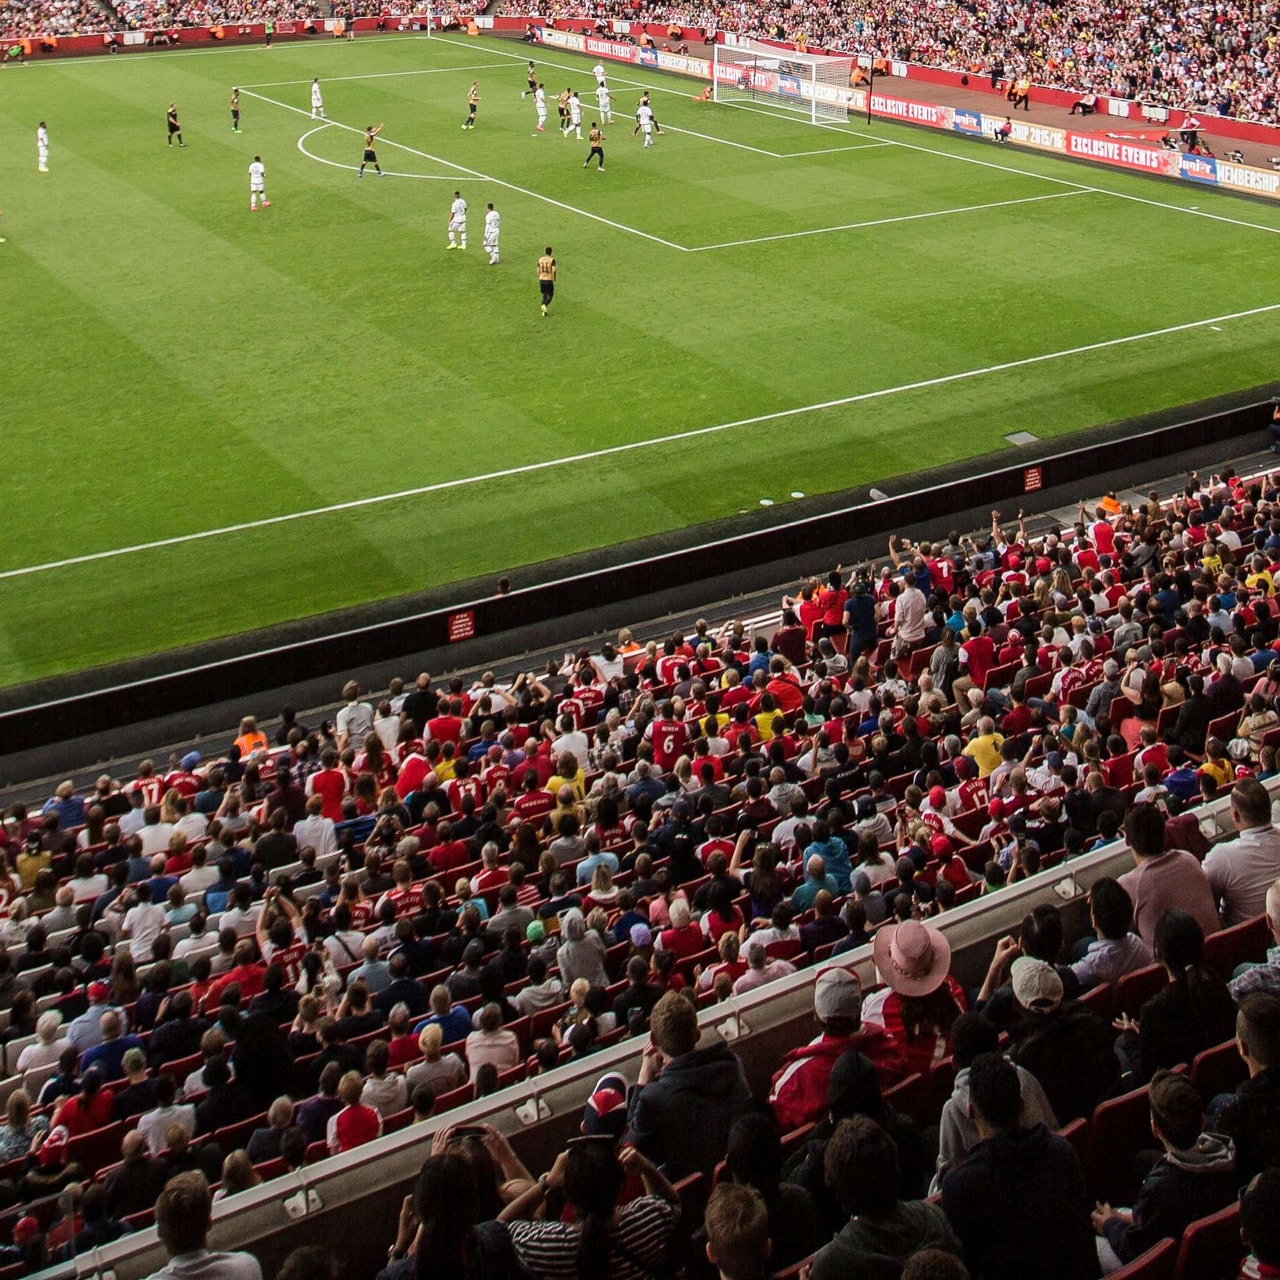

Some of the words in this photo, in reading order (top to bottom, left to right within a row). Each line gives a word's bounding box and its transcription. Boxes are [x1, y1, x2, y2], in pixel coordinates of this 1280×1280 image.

[587, 39, 612, 54] EXCLUSIVE
[613, 43, 631, 58] EVENTS
[870, 95, 907, 116] EXCLUSIVE
[909, 103, 937, 122] EVENTS
[1071, 135, 1120, 161] EXCLUSIVE
[1121, 147, 1158, 168] EVENTS
[1217, 164, 1279, 194] MEMBERSHIP
[663, 735, 674, 754] 6
[972, 790, 989, 809] 17
